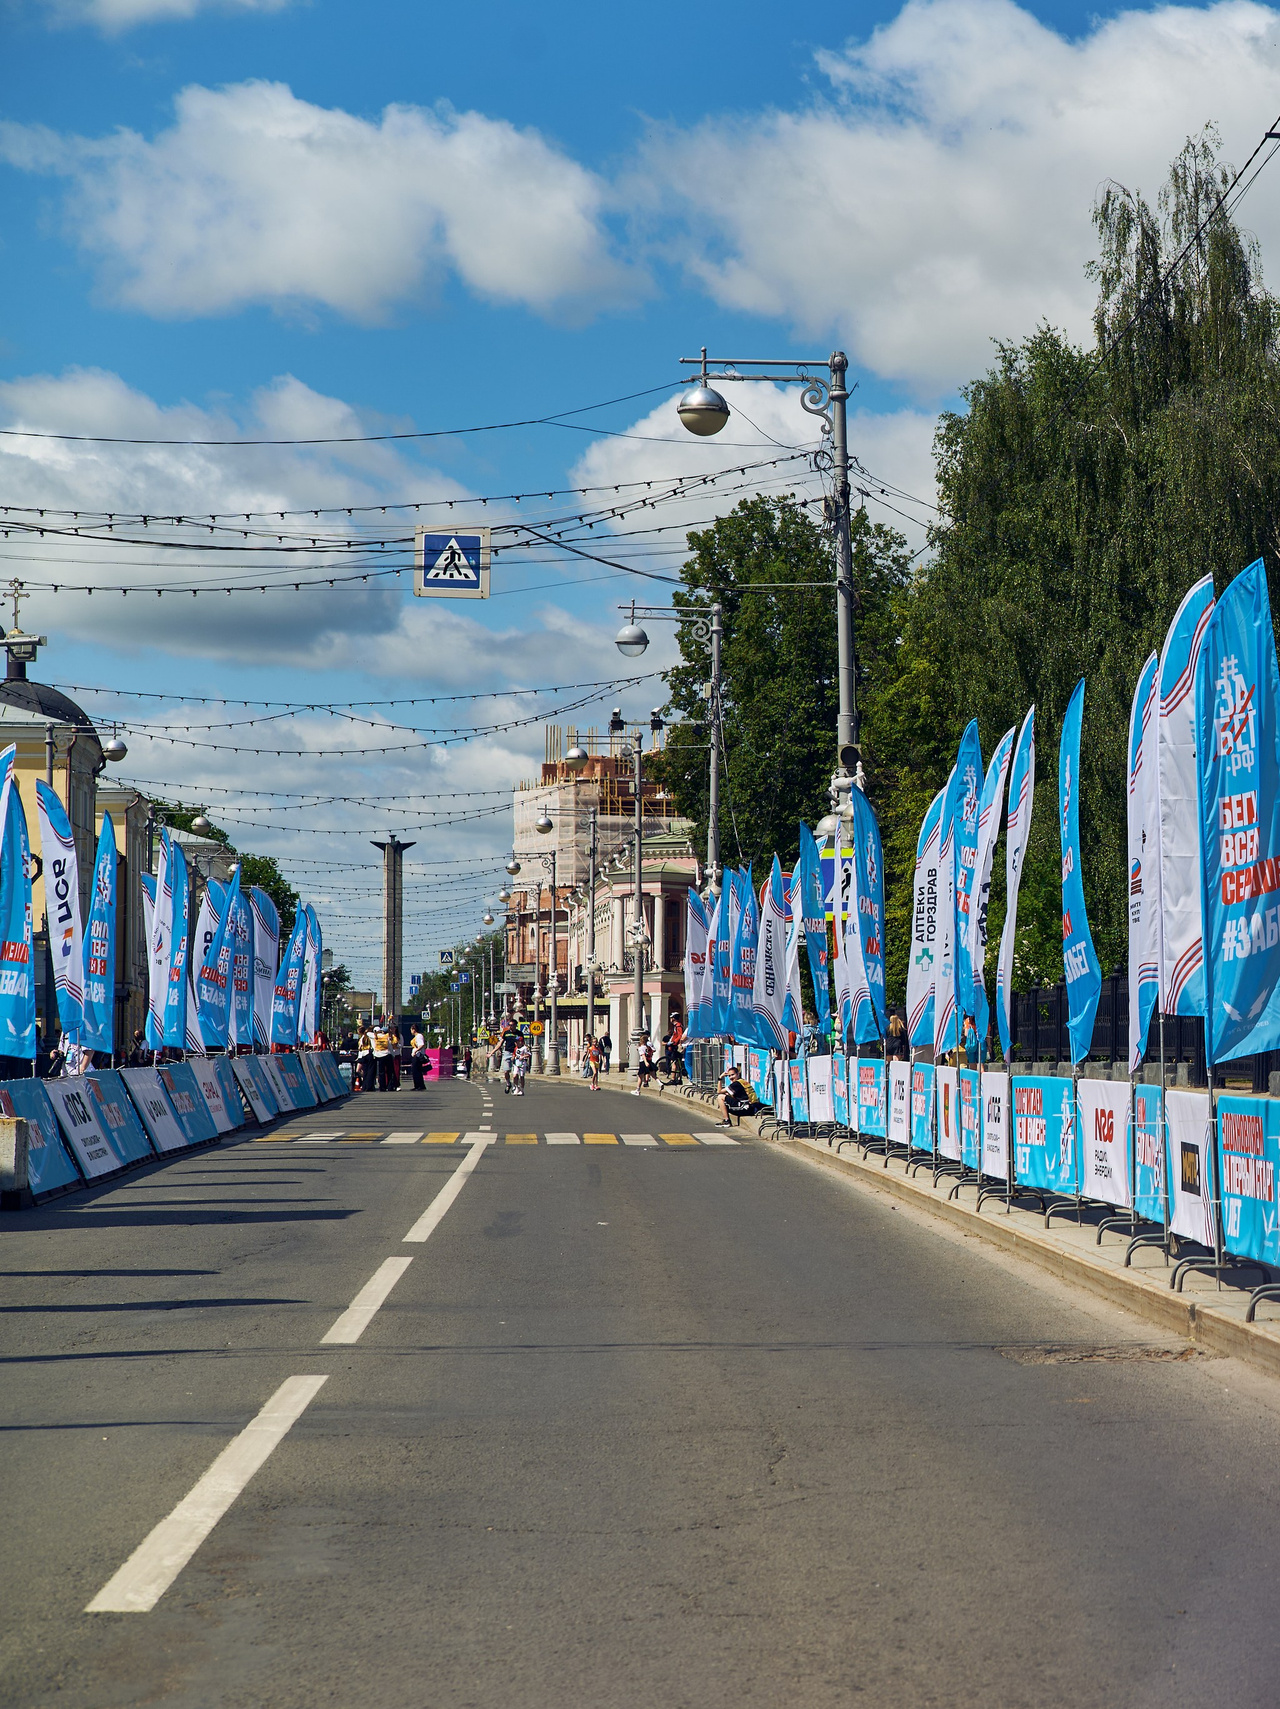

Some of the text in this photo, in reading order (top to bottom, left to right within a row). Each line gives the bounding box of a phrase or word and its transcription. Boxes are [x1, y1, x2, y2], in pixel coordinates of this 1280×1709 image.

[915, 886, 926, 942] АПТЕКИ
[927, 868, 938, 942] ГОРЗДРАВ
[1094, 1108, 1114, 1143] NRG
